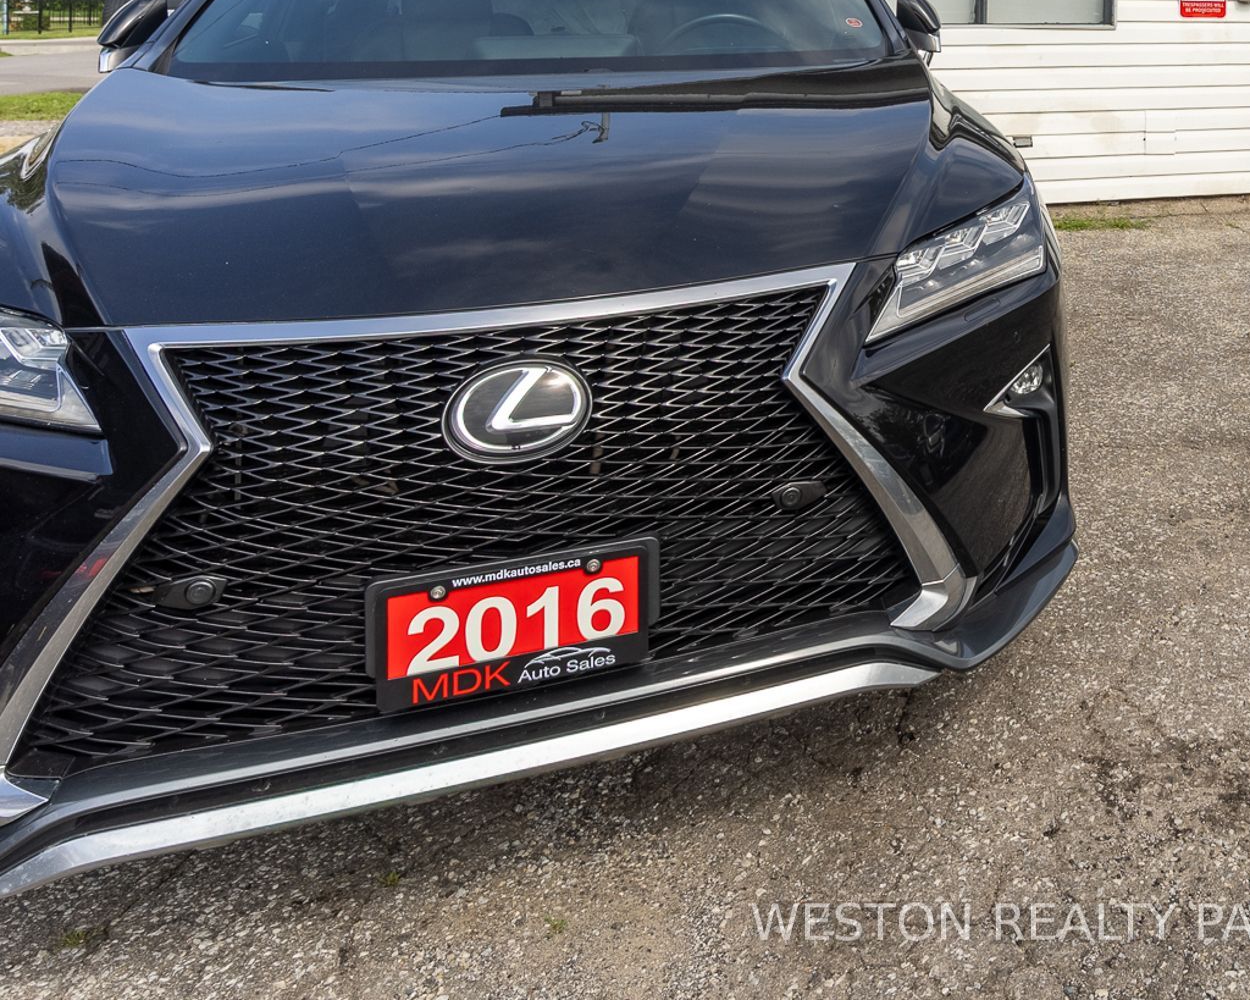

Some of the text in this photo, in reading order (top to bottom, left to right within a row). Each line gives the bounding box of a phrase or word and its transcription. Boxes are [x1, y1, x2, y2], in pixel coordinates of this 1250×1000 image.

[452, 558, 582, 588] www.mdkautosales.ca
[406, 577, 625, 676] 2016
[412, 653, 616, 704] MDK Auto Sales
